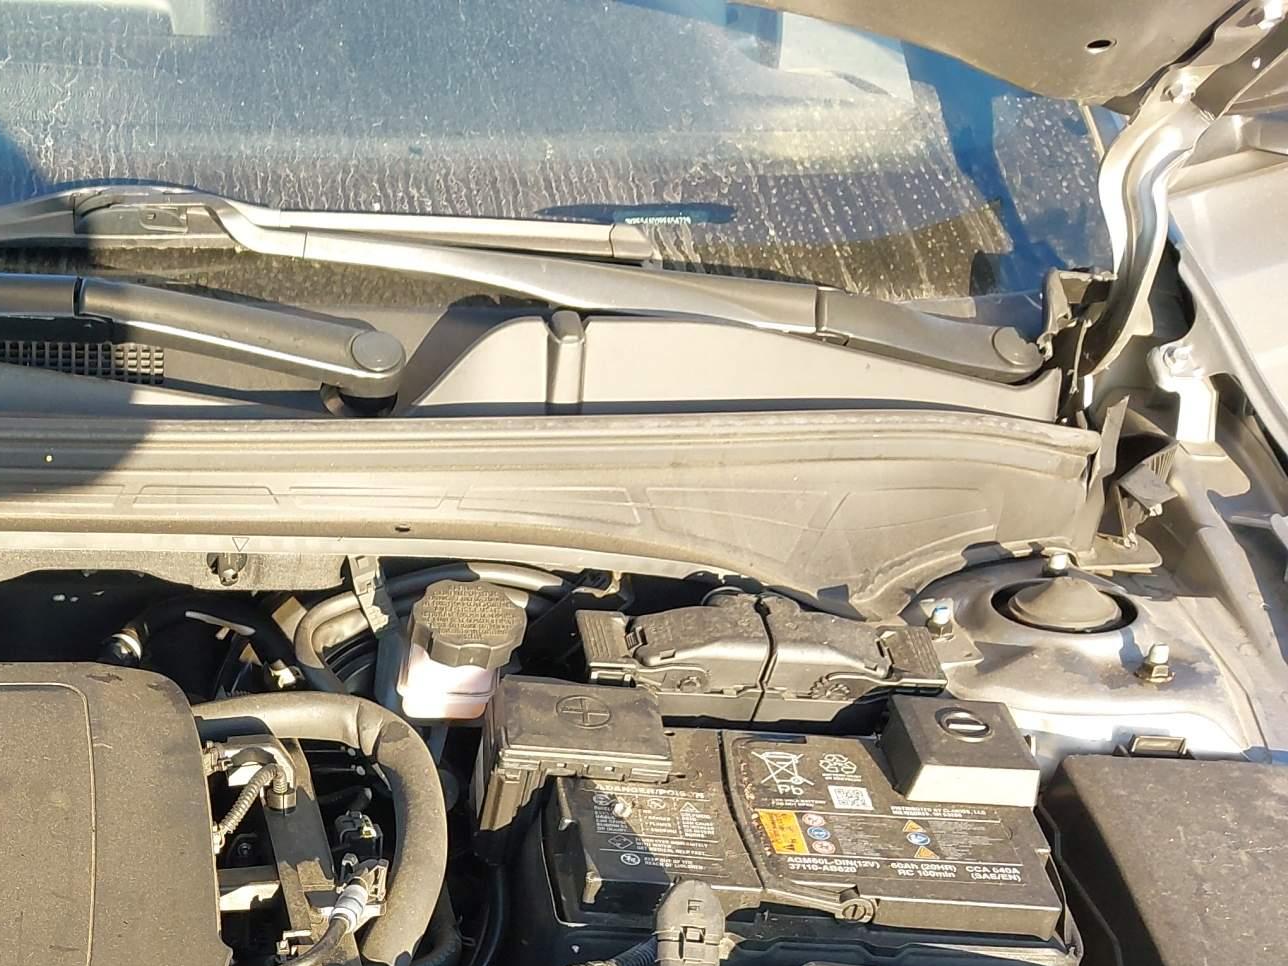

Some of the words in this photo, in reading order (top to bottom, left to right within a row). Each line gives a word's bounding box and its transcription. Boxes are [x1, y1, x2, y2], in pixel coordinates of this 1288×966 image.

[777, 784, 804, 796] Pb
[890, 862, 919, 871] 60Ah
[920, 863, 957, 873] (20HR)
[965, 865, 991, 874] CCA
[897, 869, 915, 877] RC
[917, 870, 956, 878] 100min
[971, 872, 1022, 882] (SAE/EN)
